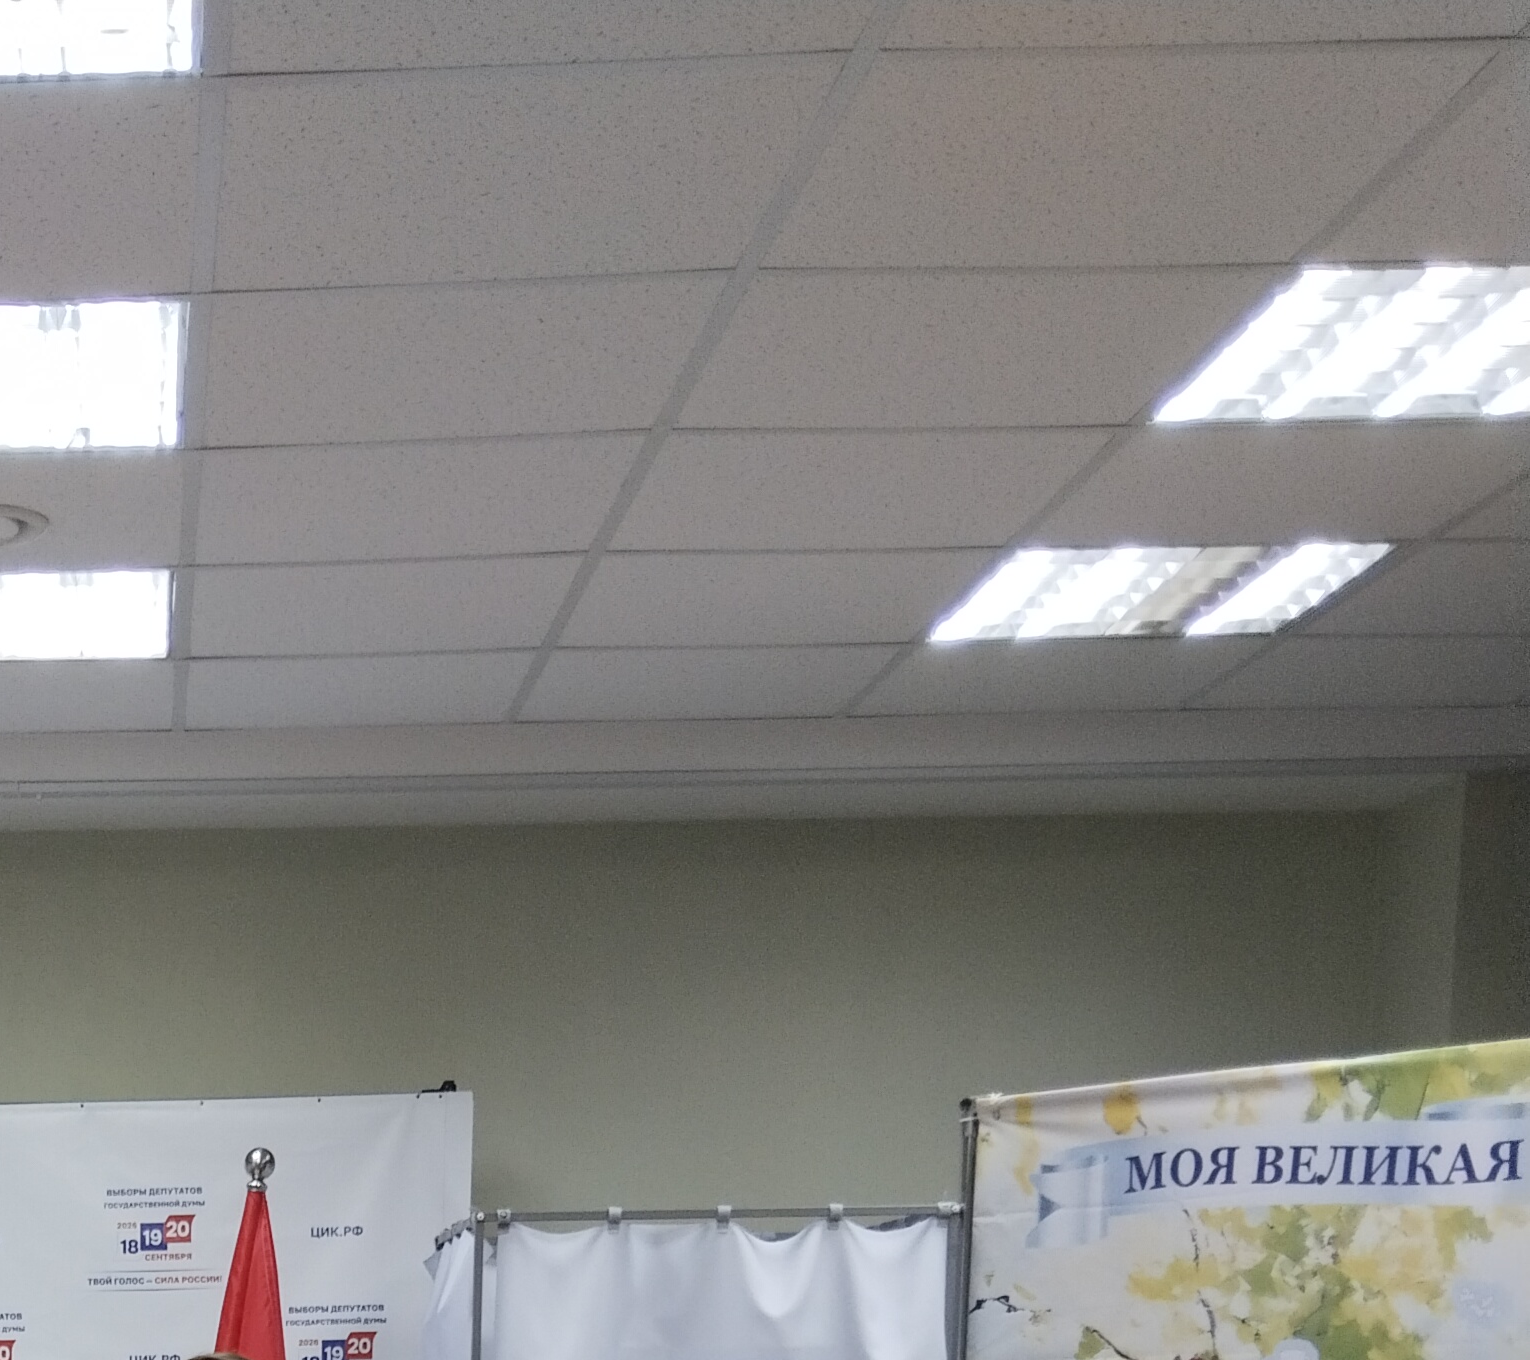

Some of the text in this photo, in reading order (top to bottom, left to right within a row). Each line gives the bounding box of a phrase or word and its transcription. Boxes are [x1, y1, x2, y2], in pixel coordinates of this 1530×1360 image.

[1124, 1139, 1524, 1194] МОЯ ВЕЛИКАЯ
[149, 1187, 202, 1196] ДЕПУТАТОВ
[104, 1200, 179, 1209] ГОСУДАРСТВЕННОЙ
[311, 1226, 363, 1238] ЦИК.РФ
[120, 1221, 189, 1254] 18 19 20
[88, 1277, 112, 1286] ТВОЙ
[289, 1305, 384, 1314] ВЫБОРЫ ДЕПУТАТОВ
[286, 1318, 361, 1326] ГОСУДАРСТВЕННОЙ
[348, 1338, 371, 1354] 20
